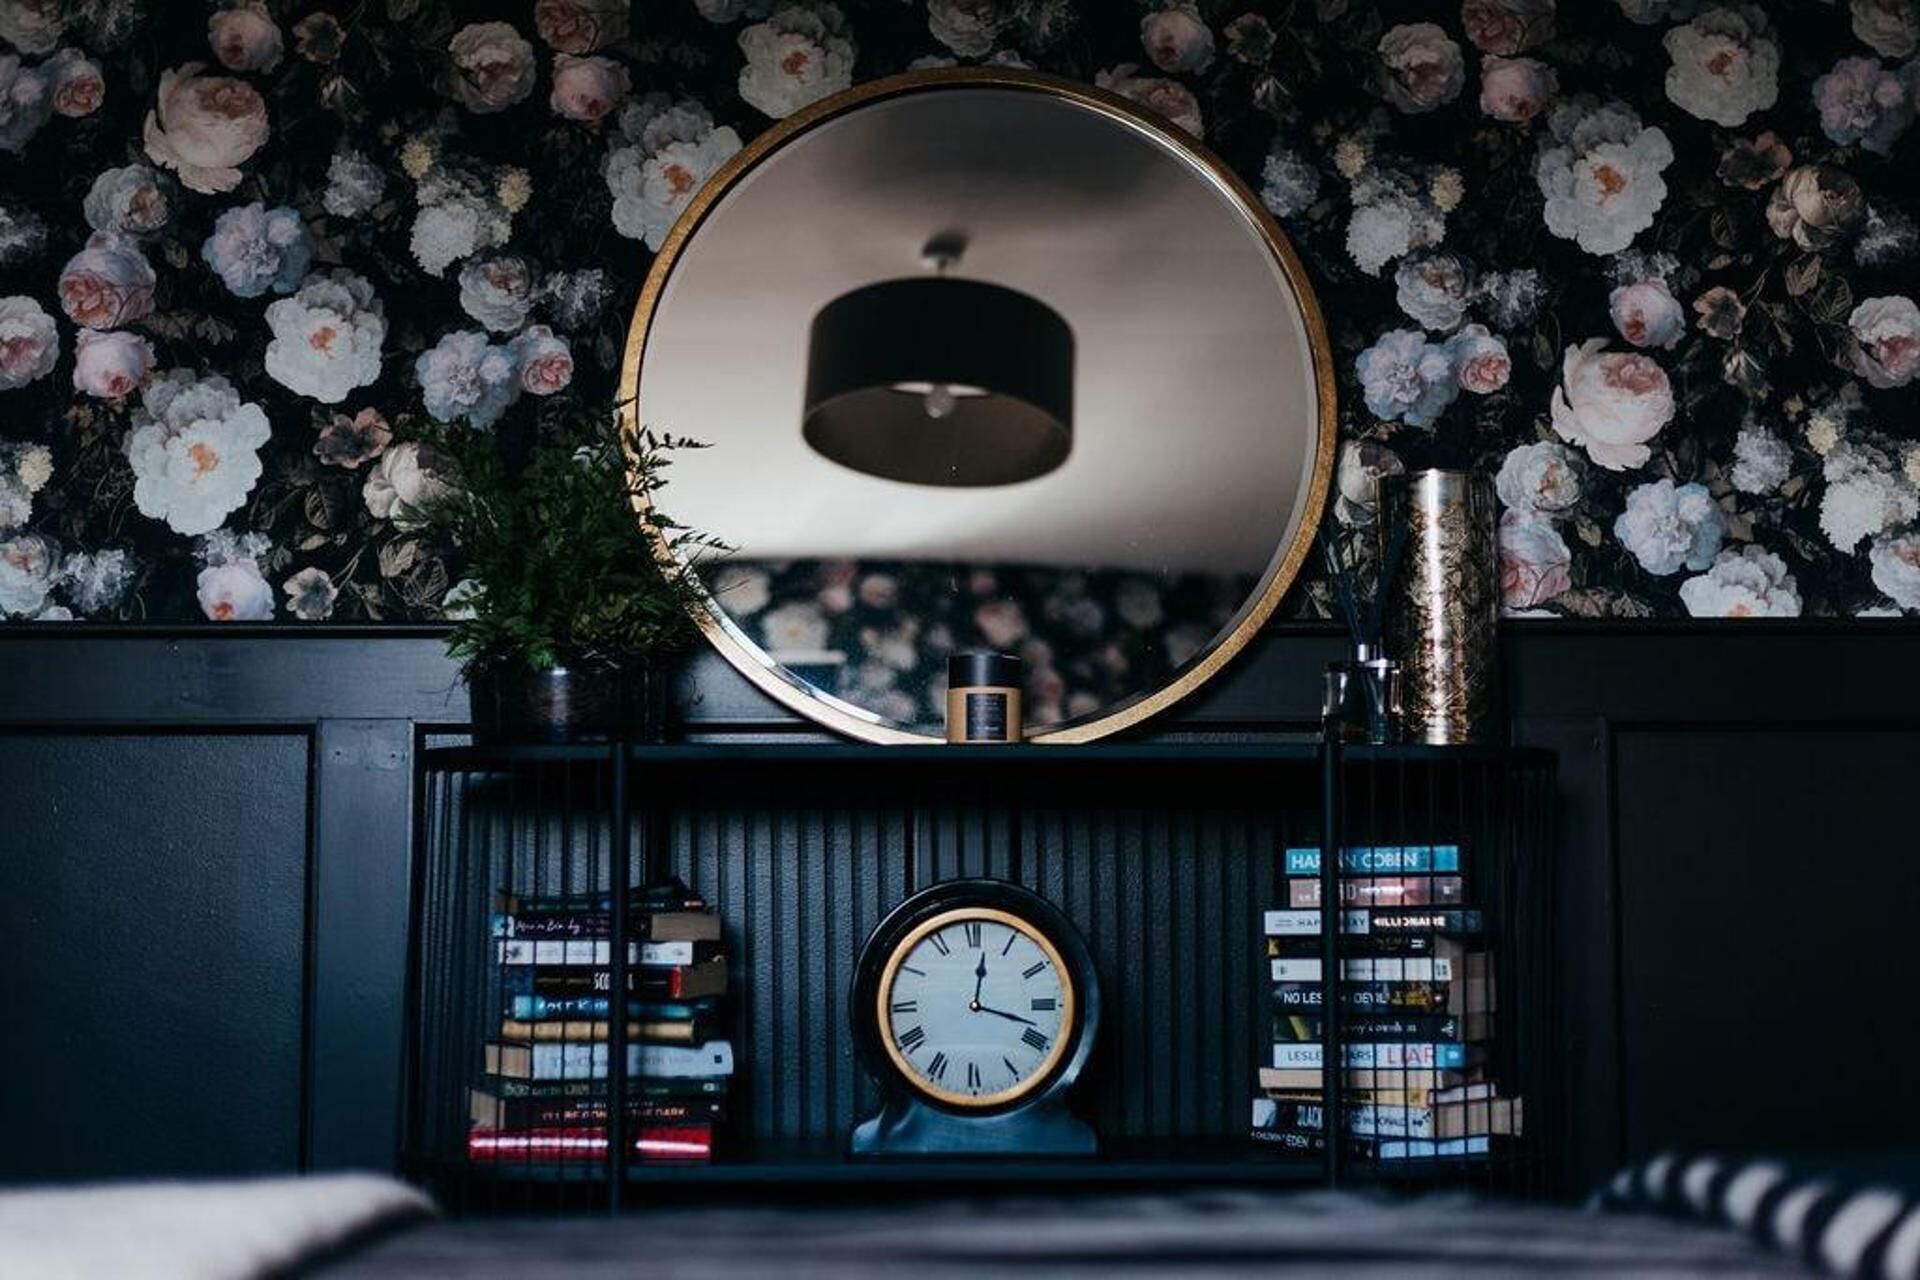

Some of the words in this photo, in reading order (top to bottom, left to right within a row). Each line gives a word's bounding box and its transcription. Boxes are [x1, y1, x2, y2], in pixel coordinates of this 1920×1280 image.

[1291, 853, 1357, 869] HARN
[1361, 852, 1418, 867] COBEN
[1284, 992, 1300, 1004] NO
[1302, 992, 1328, 1004] LES
[1288, 1051, 1328, 1061] LESLE
